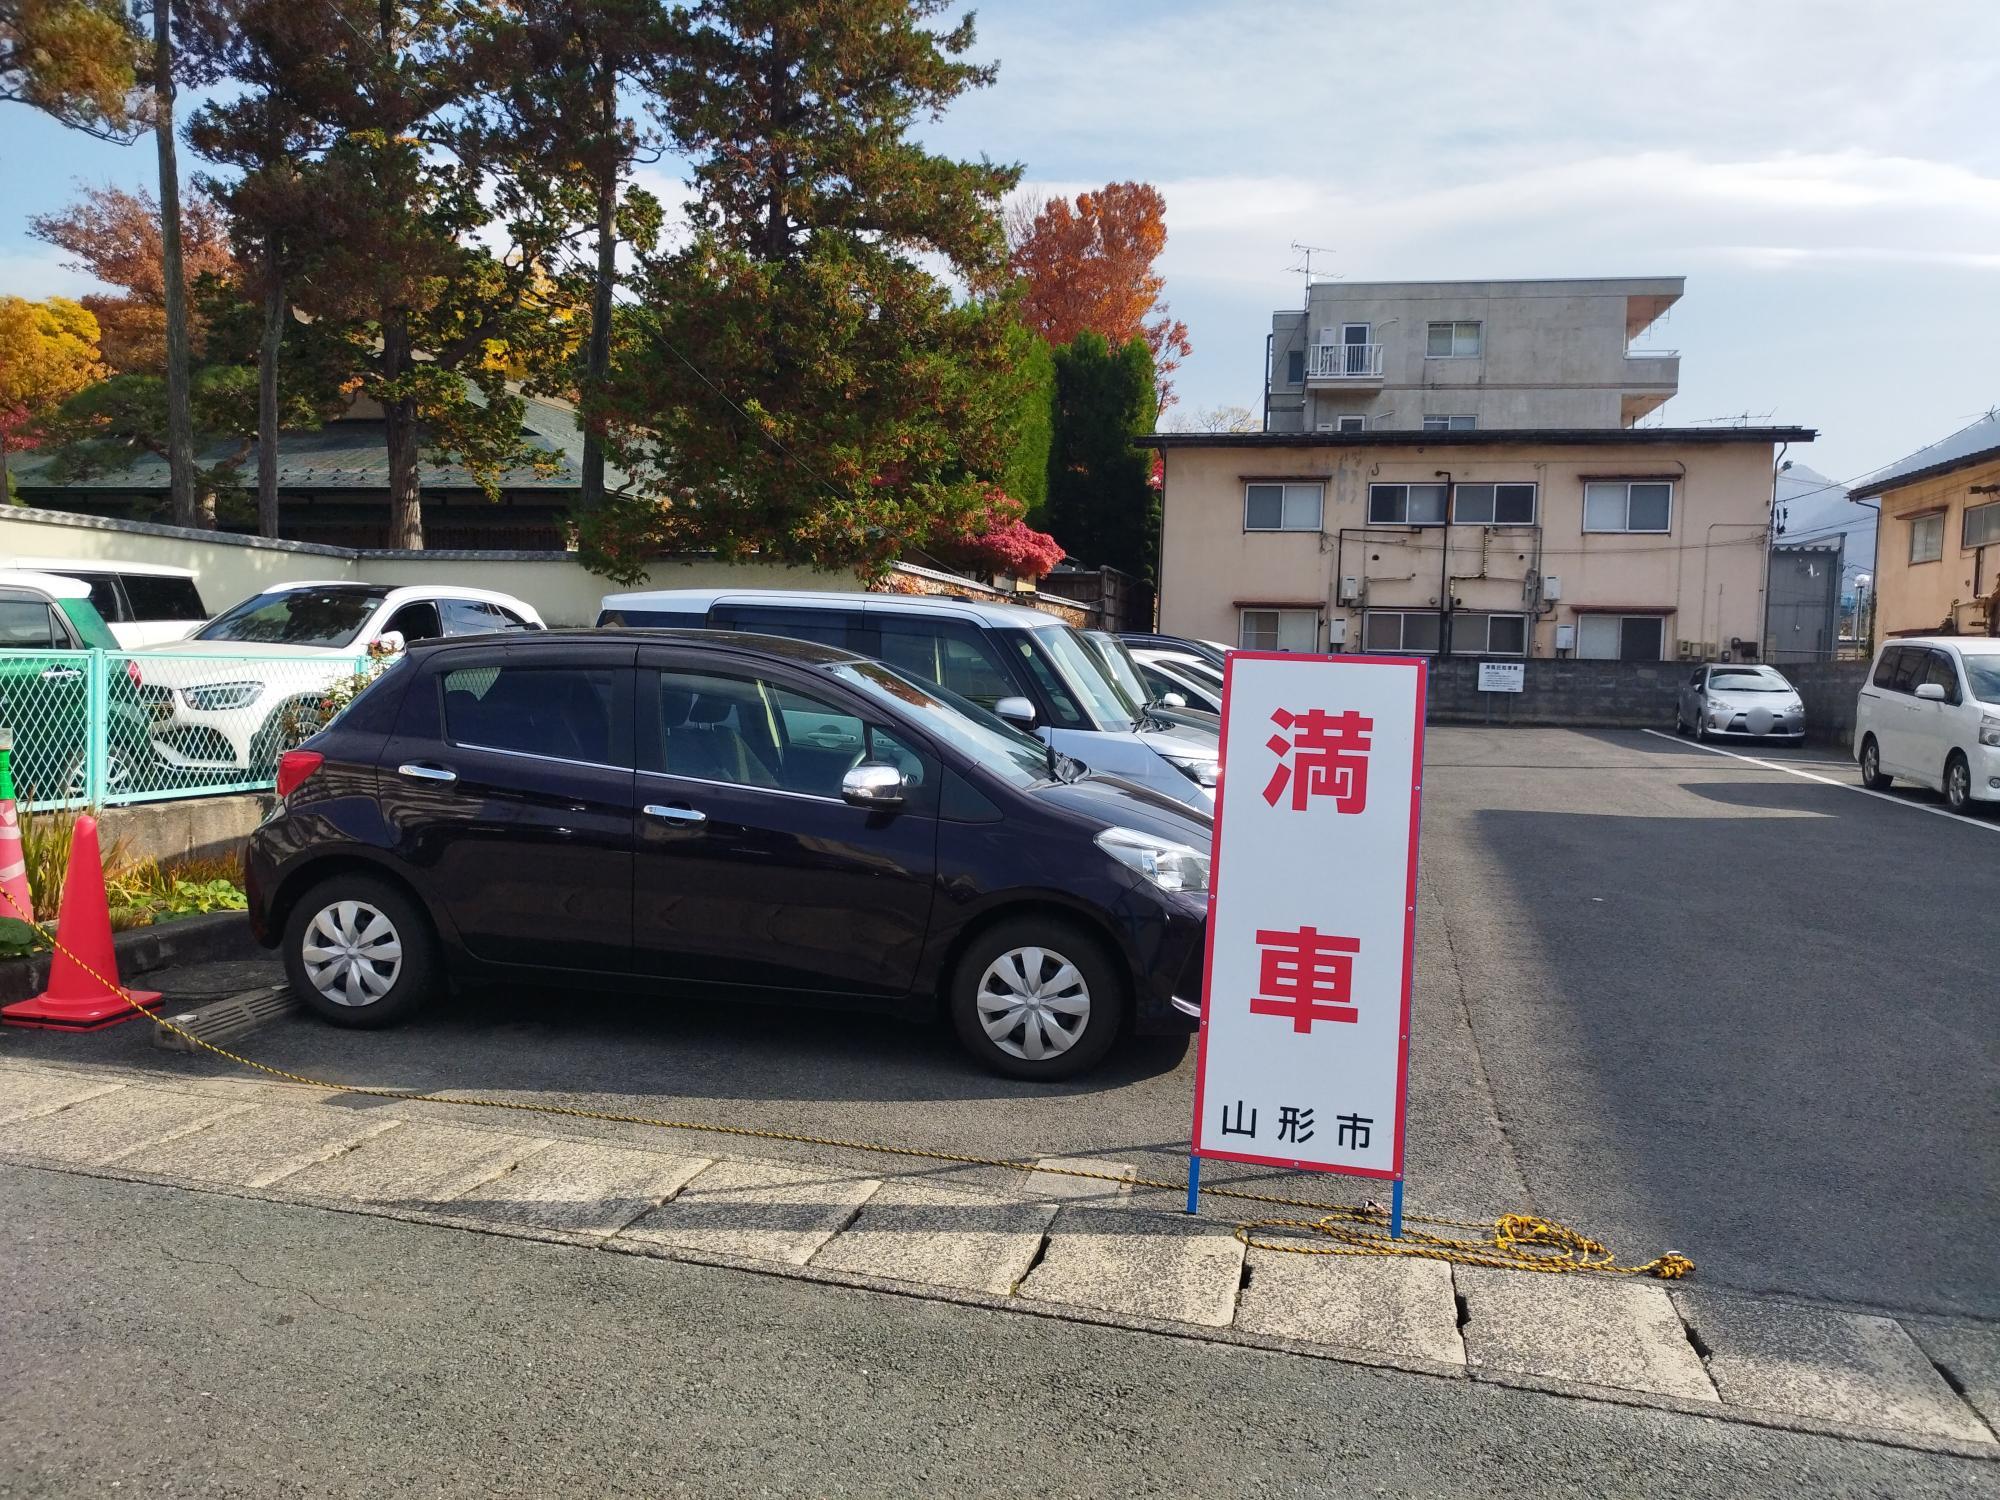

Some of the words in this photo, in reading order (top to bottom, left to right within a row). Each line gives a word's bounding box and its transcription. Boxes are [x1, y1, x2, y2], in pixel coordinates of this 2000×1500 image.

[1250, 708, 1374, 1035] 満車
[1221, 1100, 1374, 1151] 山形市
